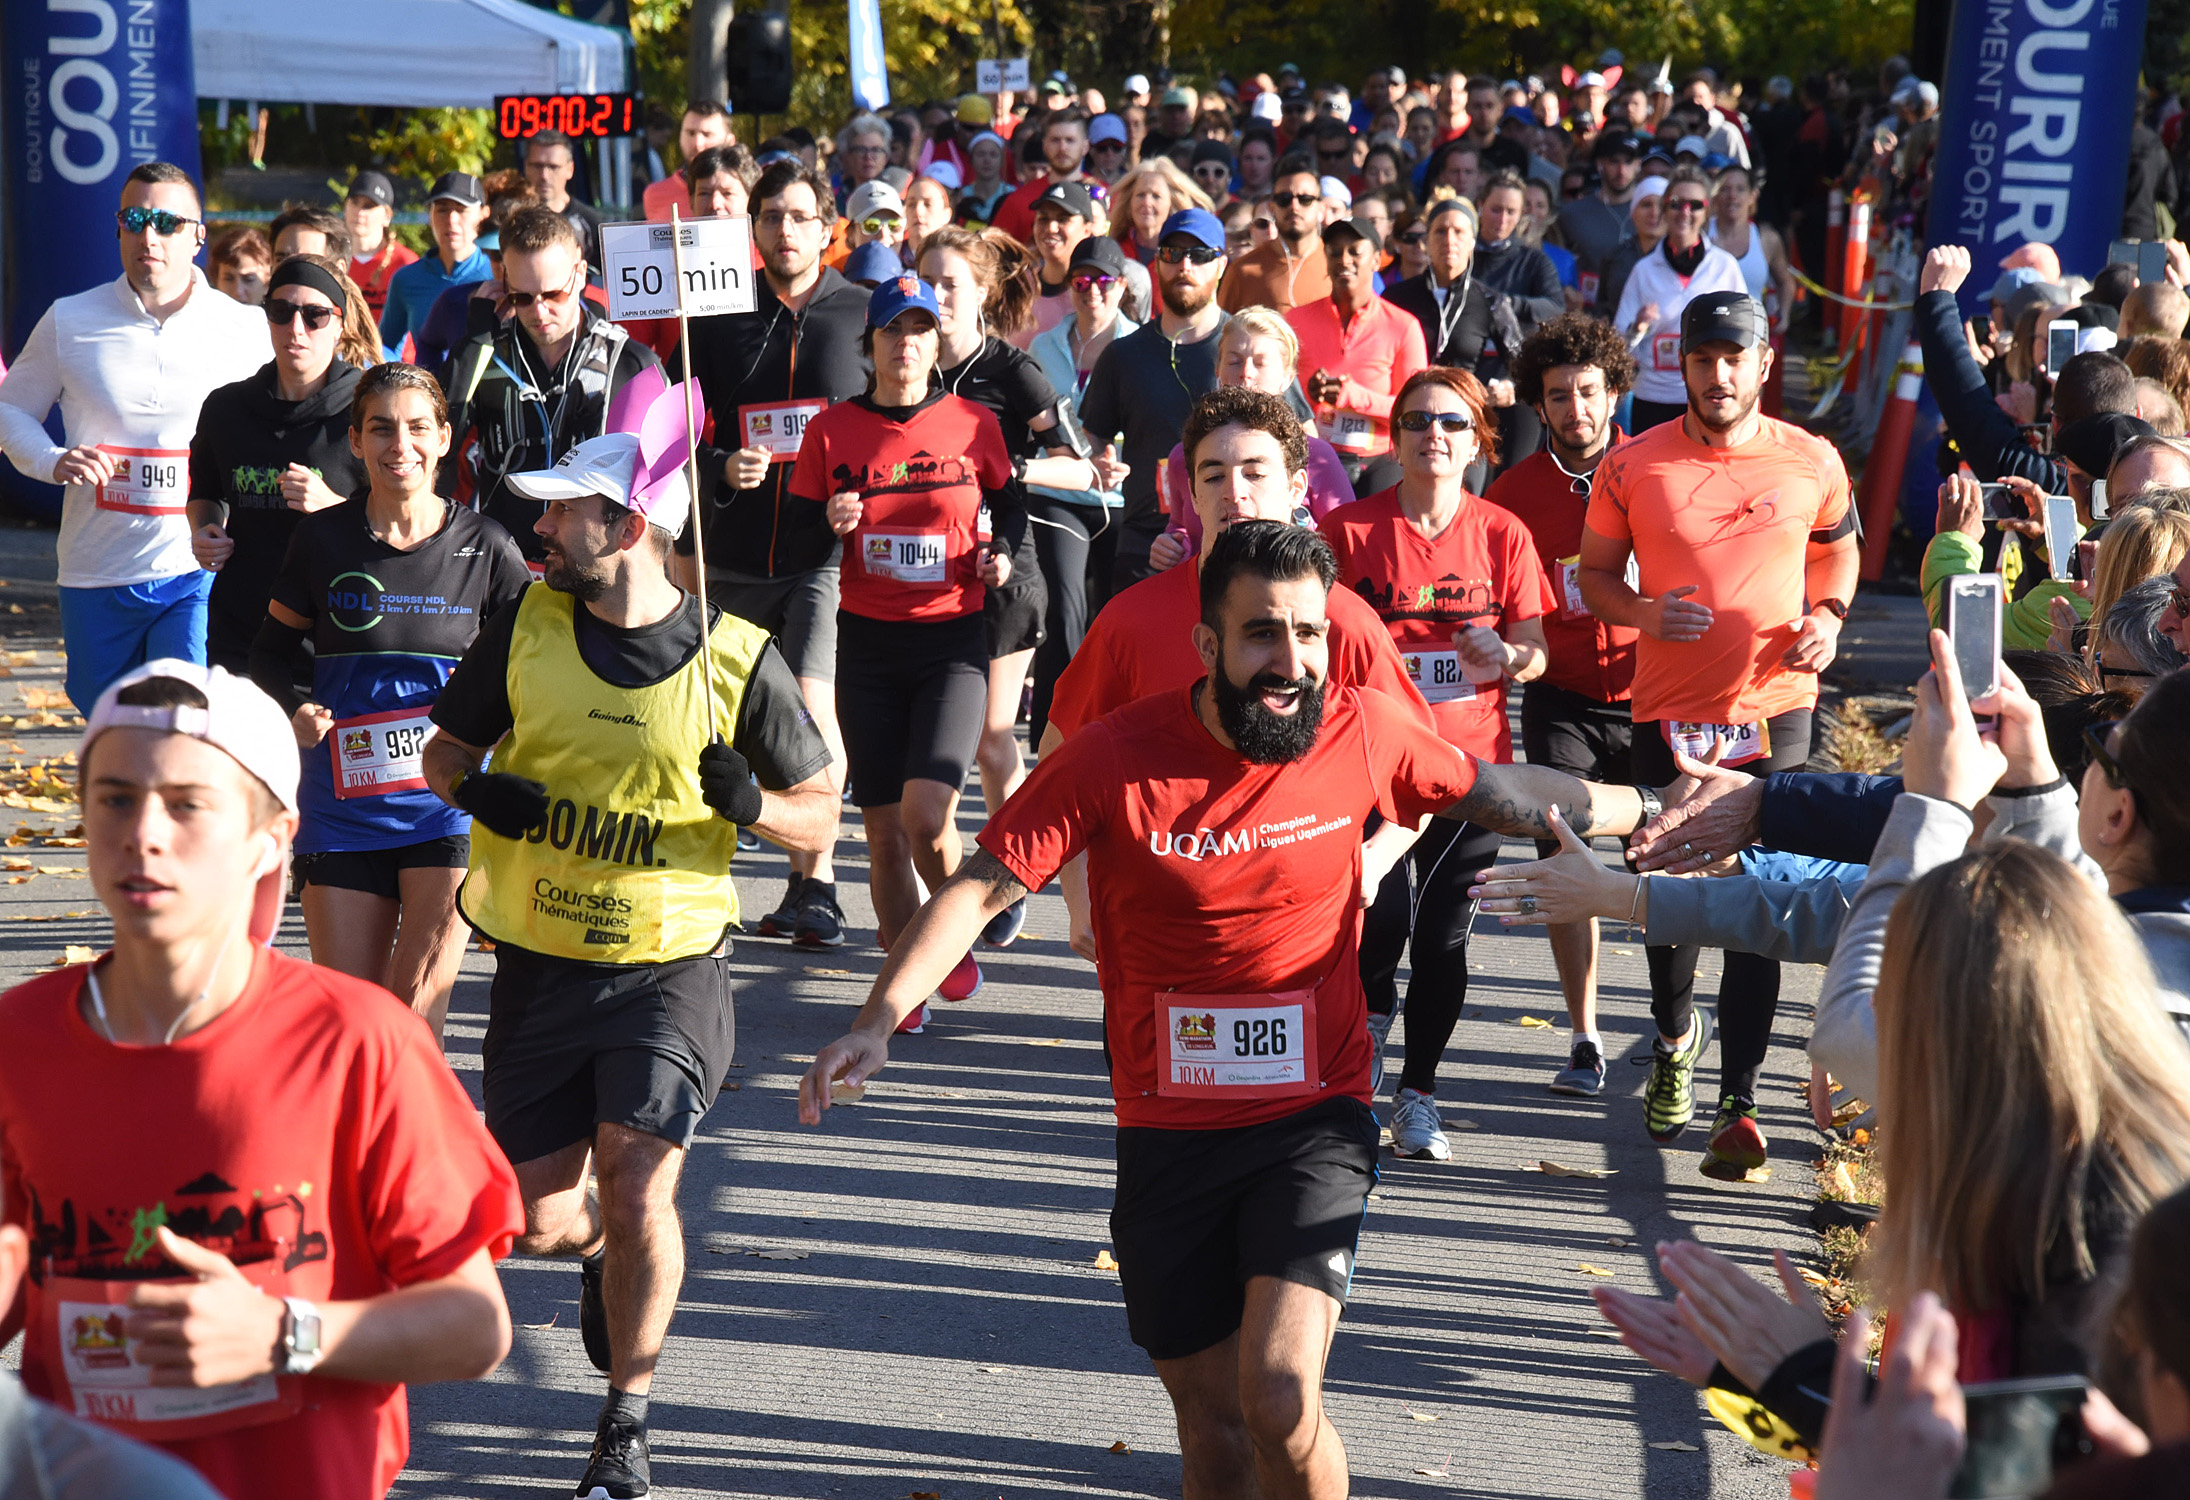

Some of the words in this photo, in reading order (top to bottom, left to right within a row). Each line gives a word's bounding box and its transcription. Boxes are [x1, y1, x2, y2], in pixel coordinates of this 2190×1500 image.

[24, 56, 42, 184] BOUTIQUE
[1957, 118, 1999, 244] SPORT
[653, 228, 692, 237] Coues
[621, 265, 663, 297] 50
[682, 261, 739, 292] min
[783, 414, 808, 436] 919
[142, 464, 176, 488] 949
[899, 543, 938, 565] 1044
[328, 591, 373, 612] NDL
[378, 604, 386, 612] 2
[387, 604, 403, 613] km
[413, 606, 421, 614] 5
[422, 605, 438, 614] km
[379, 594, 423, 605] COURSE
[425, 596, 447, 605] NDL
[385, 726, 424, 759] 932
[349, 772, 358, 787] 10
[360, 770, 378, 786] KM
[575, 805, 667, 868] MIN.
[1259, 813, 1317, 835] Champions
[1260, 835, 1295, 849] Ligues
[1297, 814, 1352, 841] Uqamicales
[1150, 827, 1251, 862] UQÀM
[534, 877, 632, 914] Courses
[531, 897, 630, 929] Thématiques
[1233, 1018, 1287, 1057] 926
[1179, 1065, 1192, 1084] 10
[1194, 1066, 1216, 1086] KM
